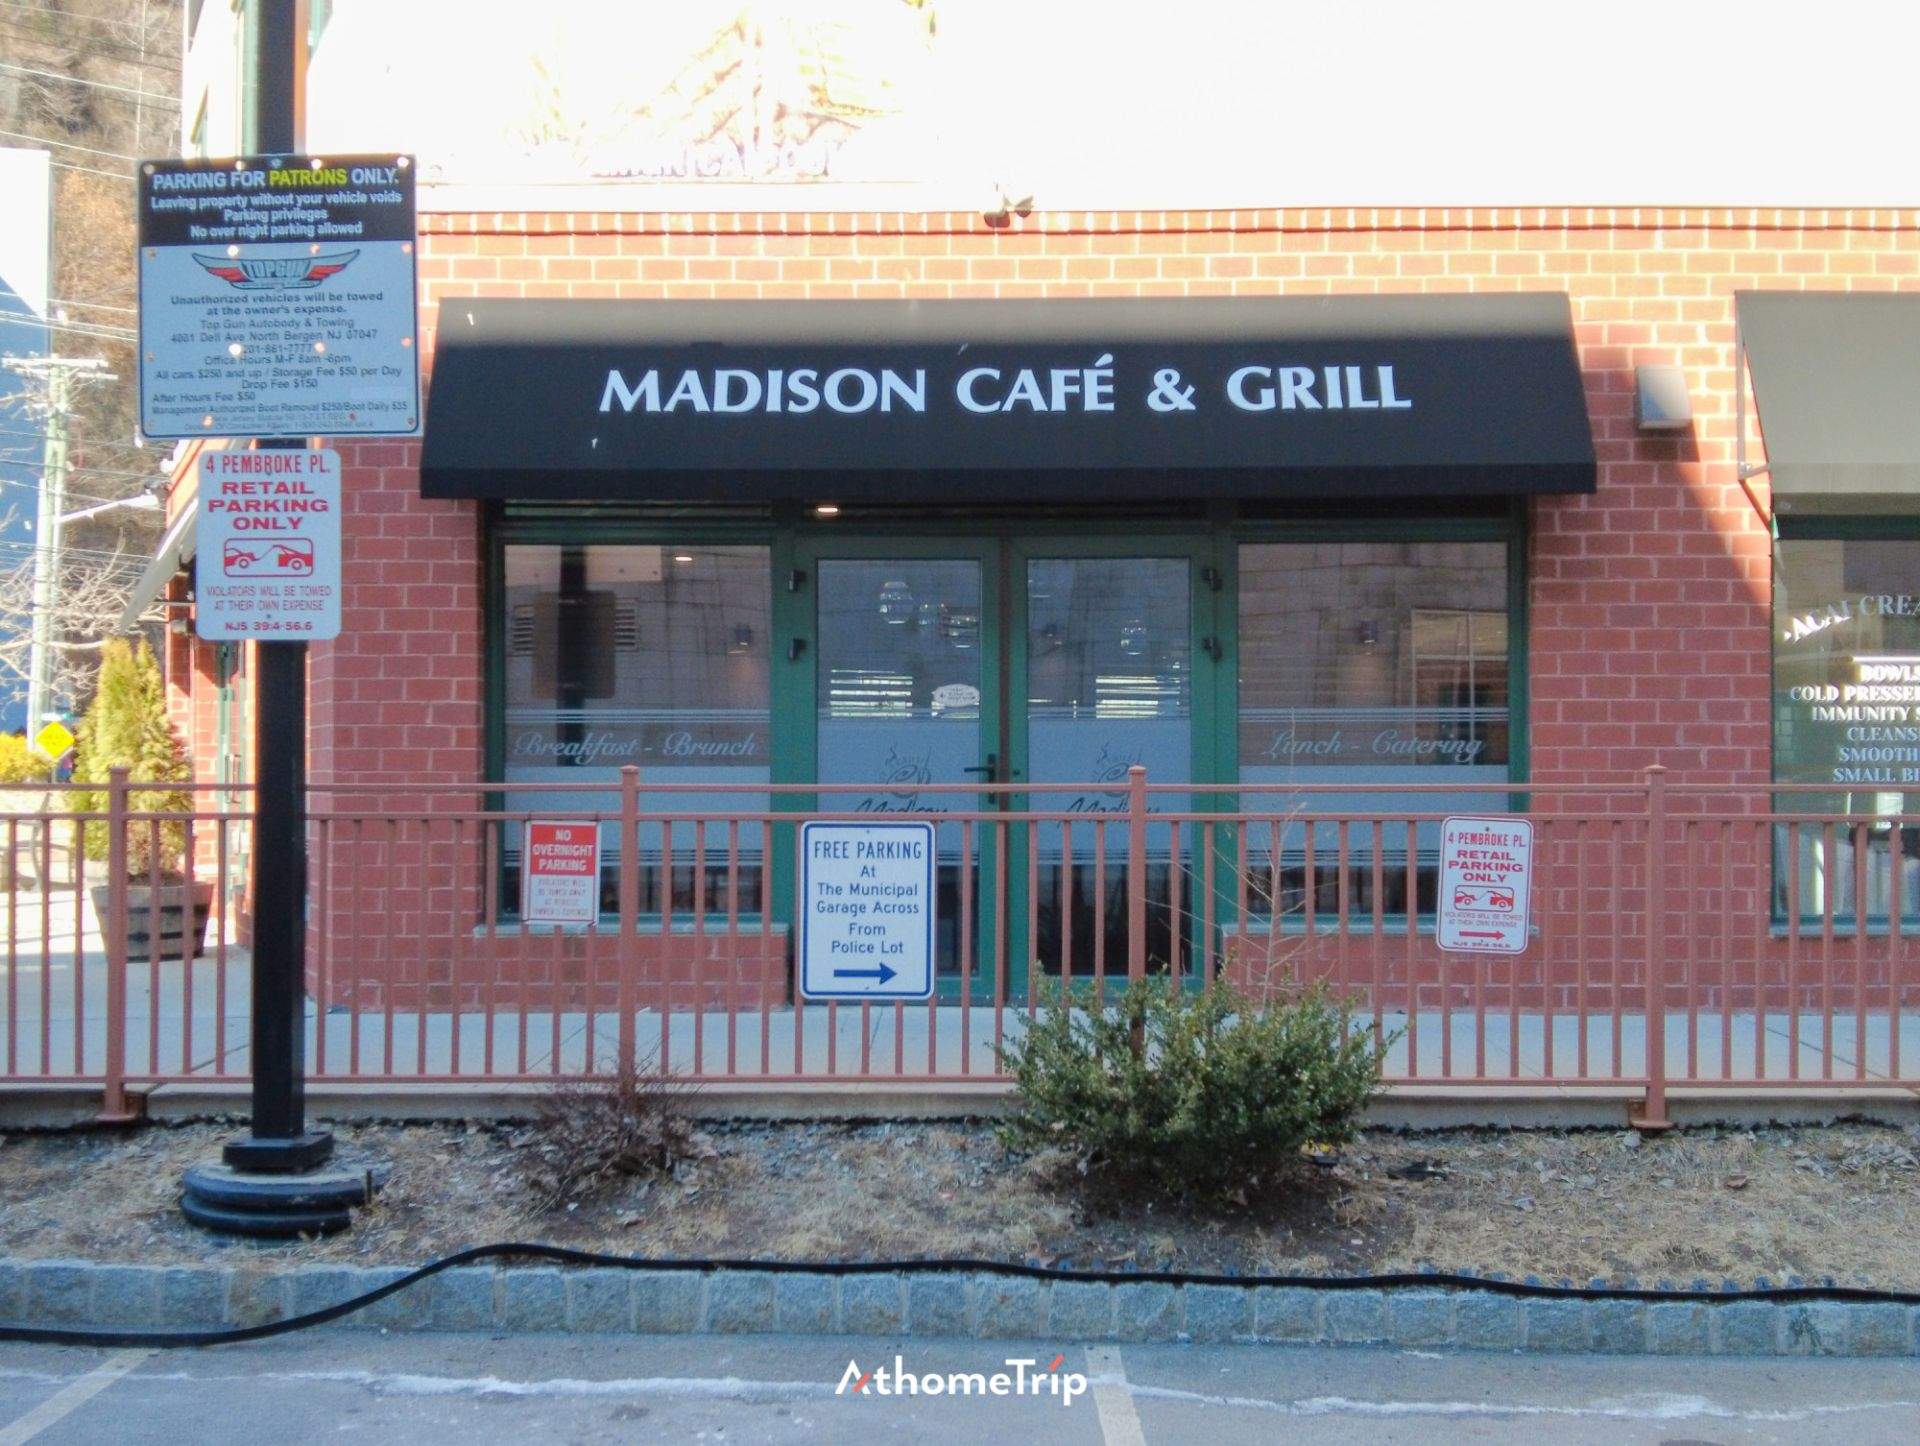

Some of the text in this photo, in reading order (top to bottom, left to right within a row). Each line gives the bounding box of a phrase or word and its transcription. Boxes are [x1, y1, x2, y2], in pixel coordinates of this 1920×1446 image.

[153, 167, 399, 190] PARKING FOR PATRONS ONLY.
[151, 190, 402, 211] Leaving property without your vehicle voids
[224, 208, 329, 223] Parking privileges
[190, 221, 363, 239] No over night parking allowed
[171, 291, 383, 305] Unauthorized vehicles will be towed
[206, 306, 219, 316] at
[222, 305, 241, 316] the
[201, 317, 354, 331] Top Gun Autobody & Towing
[249, 331, 279, 341] North
[284, 330, 322, 342] Bergen
[327, 329, 342, 340] NJ
[225, 368, 246, 378] and
[249, 369, 262, 380] up
[272, 367, 313, 379] Storage
[316, 366, 335, 377] Fee
[338, 365, 358, 377] $50
[361, 367, 378, 378] per
[381, 365, 401, 378] Day
[241, 378, 318, 391] Drop Fee $150
[599, 352, 1412, 414] MADISON CAFÉ & GRILL
[180, 392, 211, 403] Hours
[214, 392, 234, 402] Fee
[237, 391, 256, 402] $50
[205, 454, 215, 474] 4
[222, 453, 302, 474] PEMBROKE
[222, 481, 315, 495] RETAIL
[208, 499, 329, 513] PARKING
[233, 516, 304, 531] ONLY
[206, 585, 332, 597] VIOLATORS WILL BE TOWED
[213, 599, 325, 611] AT THEIR OWN EXPENSE
[1789, 685, 1840, 702] COLD
[1811, 705, 1911, 722] IMMUNITY
[514, 731, 641, 765] Breakfast
[662, 731, 757, 757] Brunch
[1262, 728, 1341, 760] Lunch
[1371, 728, 1485, 764] Catering
[1832, 767, 1896, 783] SMALL
[554, 828, 572, 842] NO
[1458, 831, 1509, 847] PEMBROKE
[531, 843, 595, 857] OVERNIGHT
[814, 840, 922, 859] FREE PARKING
[1456, 849, 1515, 861] RETAIL
[538, 858, 587, 872] PARKING
[860, 864, 876, 878] At
[1448, 860, 1524, 873] PARKING
[1462, 872, 1507, 883] ONLY
[817, 882, 918, 898] The Municipal
[816, 900, 919, 918] Garage Across
[849, 922, 886, 936] From
[830, 940, 904, 954] Police Lot
